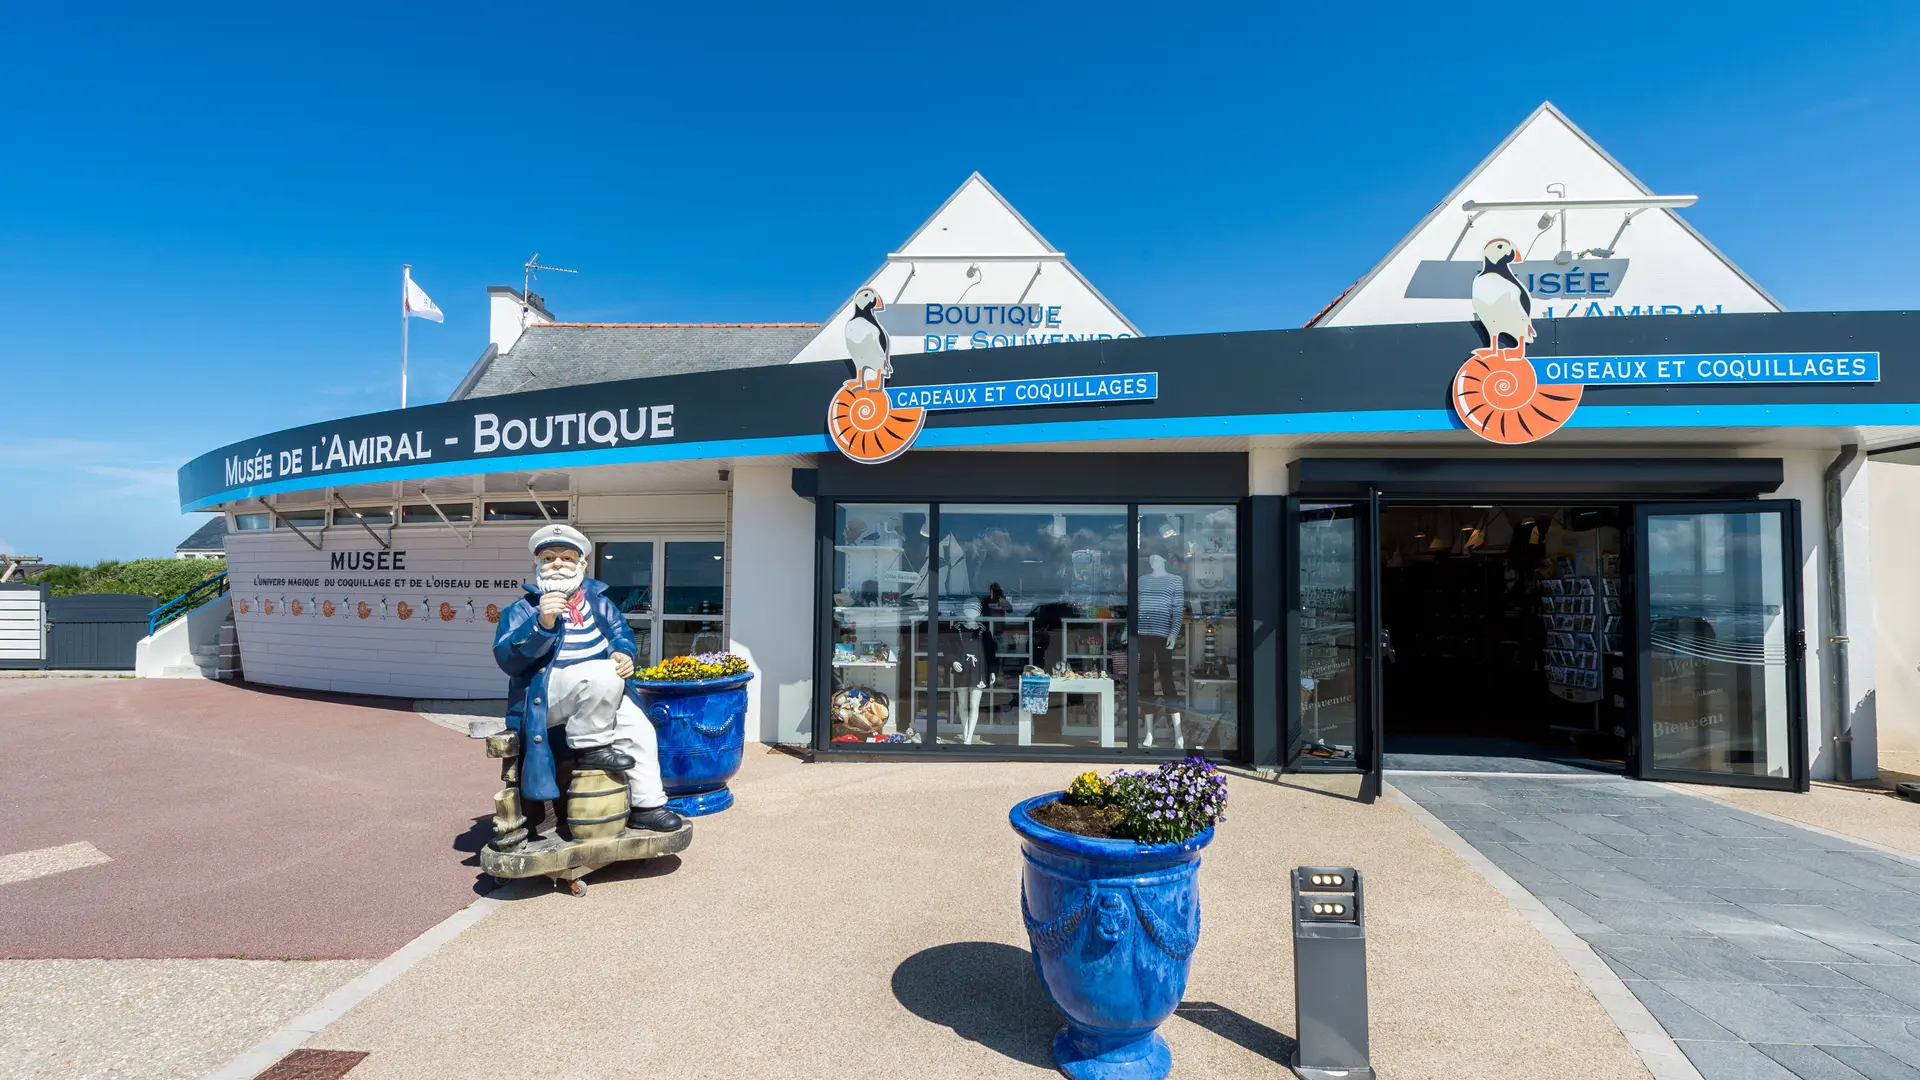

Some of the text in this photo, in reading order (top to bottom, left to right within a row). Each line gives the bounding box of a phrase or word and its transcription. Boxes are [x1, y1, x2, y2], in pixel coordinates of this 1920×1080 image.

[1514, 266, 1611, 295] SÉE
[925, 303, 1062, 326] BOUTIQUE
[925, 330, 1132, 352] DE SOUVE
[1545, 357, 1868, 380] OISEAUX ET COQUILLAGES
[897, 377, 1149, 407] CADEAUX ET COQUILLAGES
[225, 448, 273, 487] MUSÉE
[279, 448, 303, 476] DE
[311, 431, 431, 471] L'AMIRAL
[473, 404, 675, 454] BOUTIQUE
[288, 578, 320, 588] MAGIQUE
[324, 578, 335, 587] DU
[337, 578, 391, 588] COQUILLAGE
[394, 578, 407, 588] ET
[409, 579, 422, 588] DE
[426, 575, 471, 588] L'OISEAU
[475, 579, 490, 589] DE
[494, 579, 518, 589] MER
